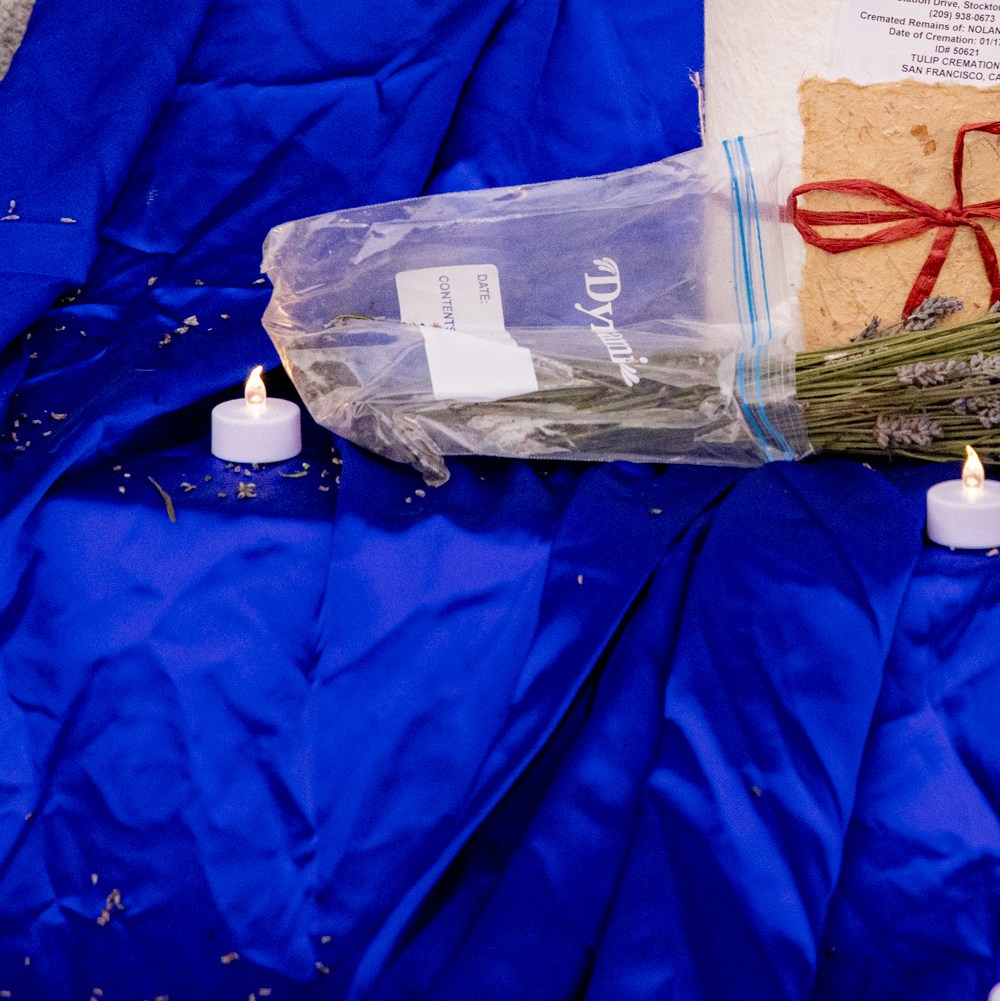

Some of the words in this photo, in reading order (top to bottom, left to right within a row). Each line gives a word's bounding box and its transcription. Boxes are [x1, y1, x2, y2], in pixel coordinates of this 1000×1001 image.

[860, 11, 905, 25] Cremated
[909, 18, 950, 31] Remains
[953, 23, 965, 32] of:
[968, 25, 1000, 35] NOLAN
[929, 10, 952, 20] (209)
[955, 12, 995, 23] 938-0673
[889, 28, 910, 38] Date
[913, 30, 923, 39] of
[926, 32, 976, 45] Cremation:
[935, 45, 950, 54] ID#
[953, 47, 979, 56] 50621
[911, 54, 939, 64] TULIP
[942, 57, 1000, 69] CREMATION
[902, 65, 922, 74] SAN
[926, 68, 985, 81] FRANCISCO,
[477, 274, 490, 304] DATE:
